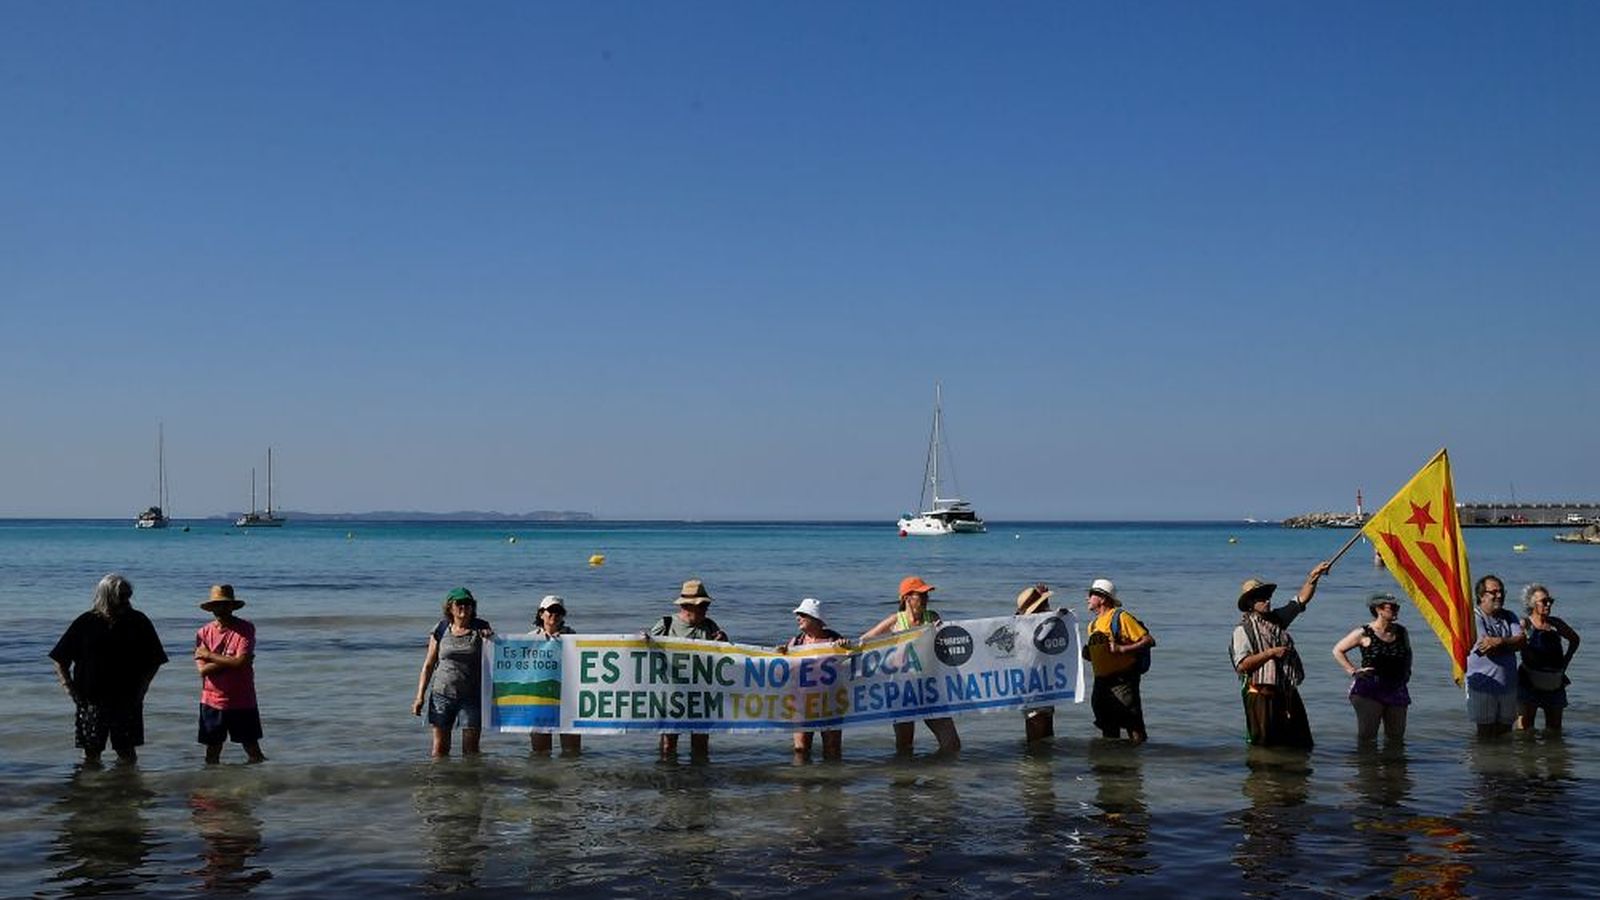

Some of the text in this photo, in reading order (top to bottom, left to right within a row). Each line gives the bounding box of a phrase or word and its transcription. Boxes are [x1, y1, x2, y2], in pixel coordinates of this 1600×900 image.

[496, 659, 558, 670] no es toca
[503, 646, 553, 659] Es Trenc
[580, 642, 922, 688] ES TRENC NO ES TOCA
[578, 663, 1068, 720] DEFENSEM TOTS ELS ESPAIS NATURALS
